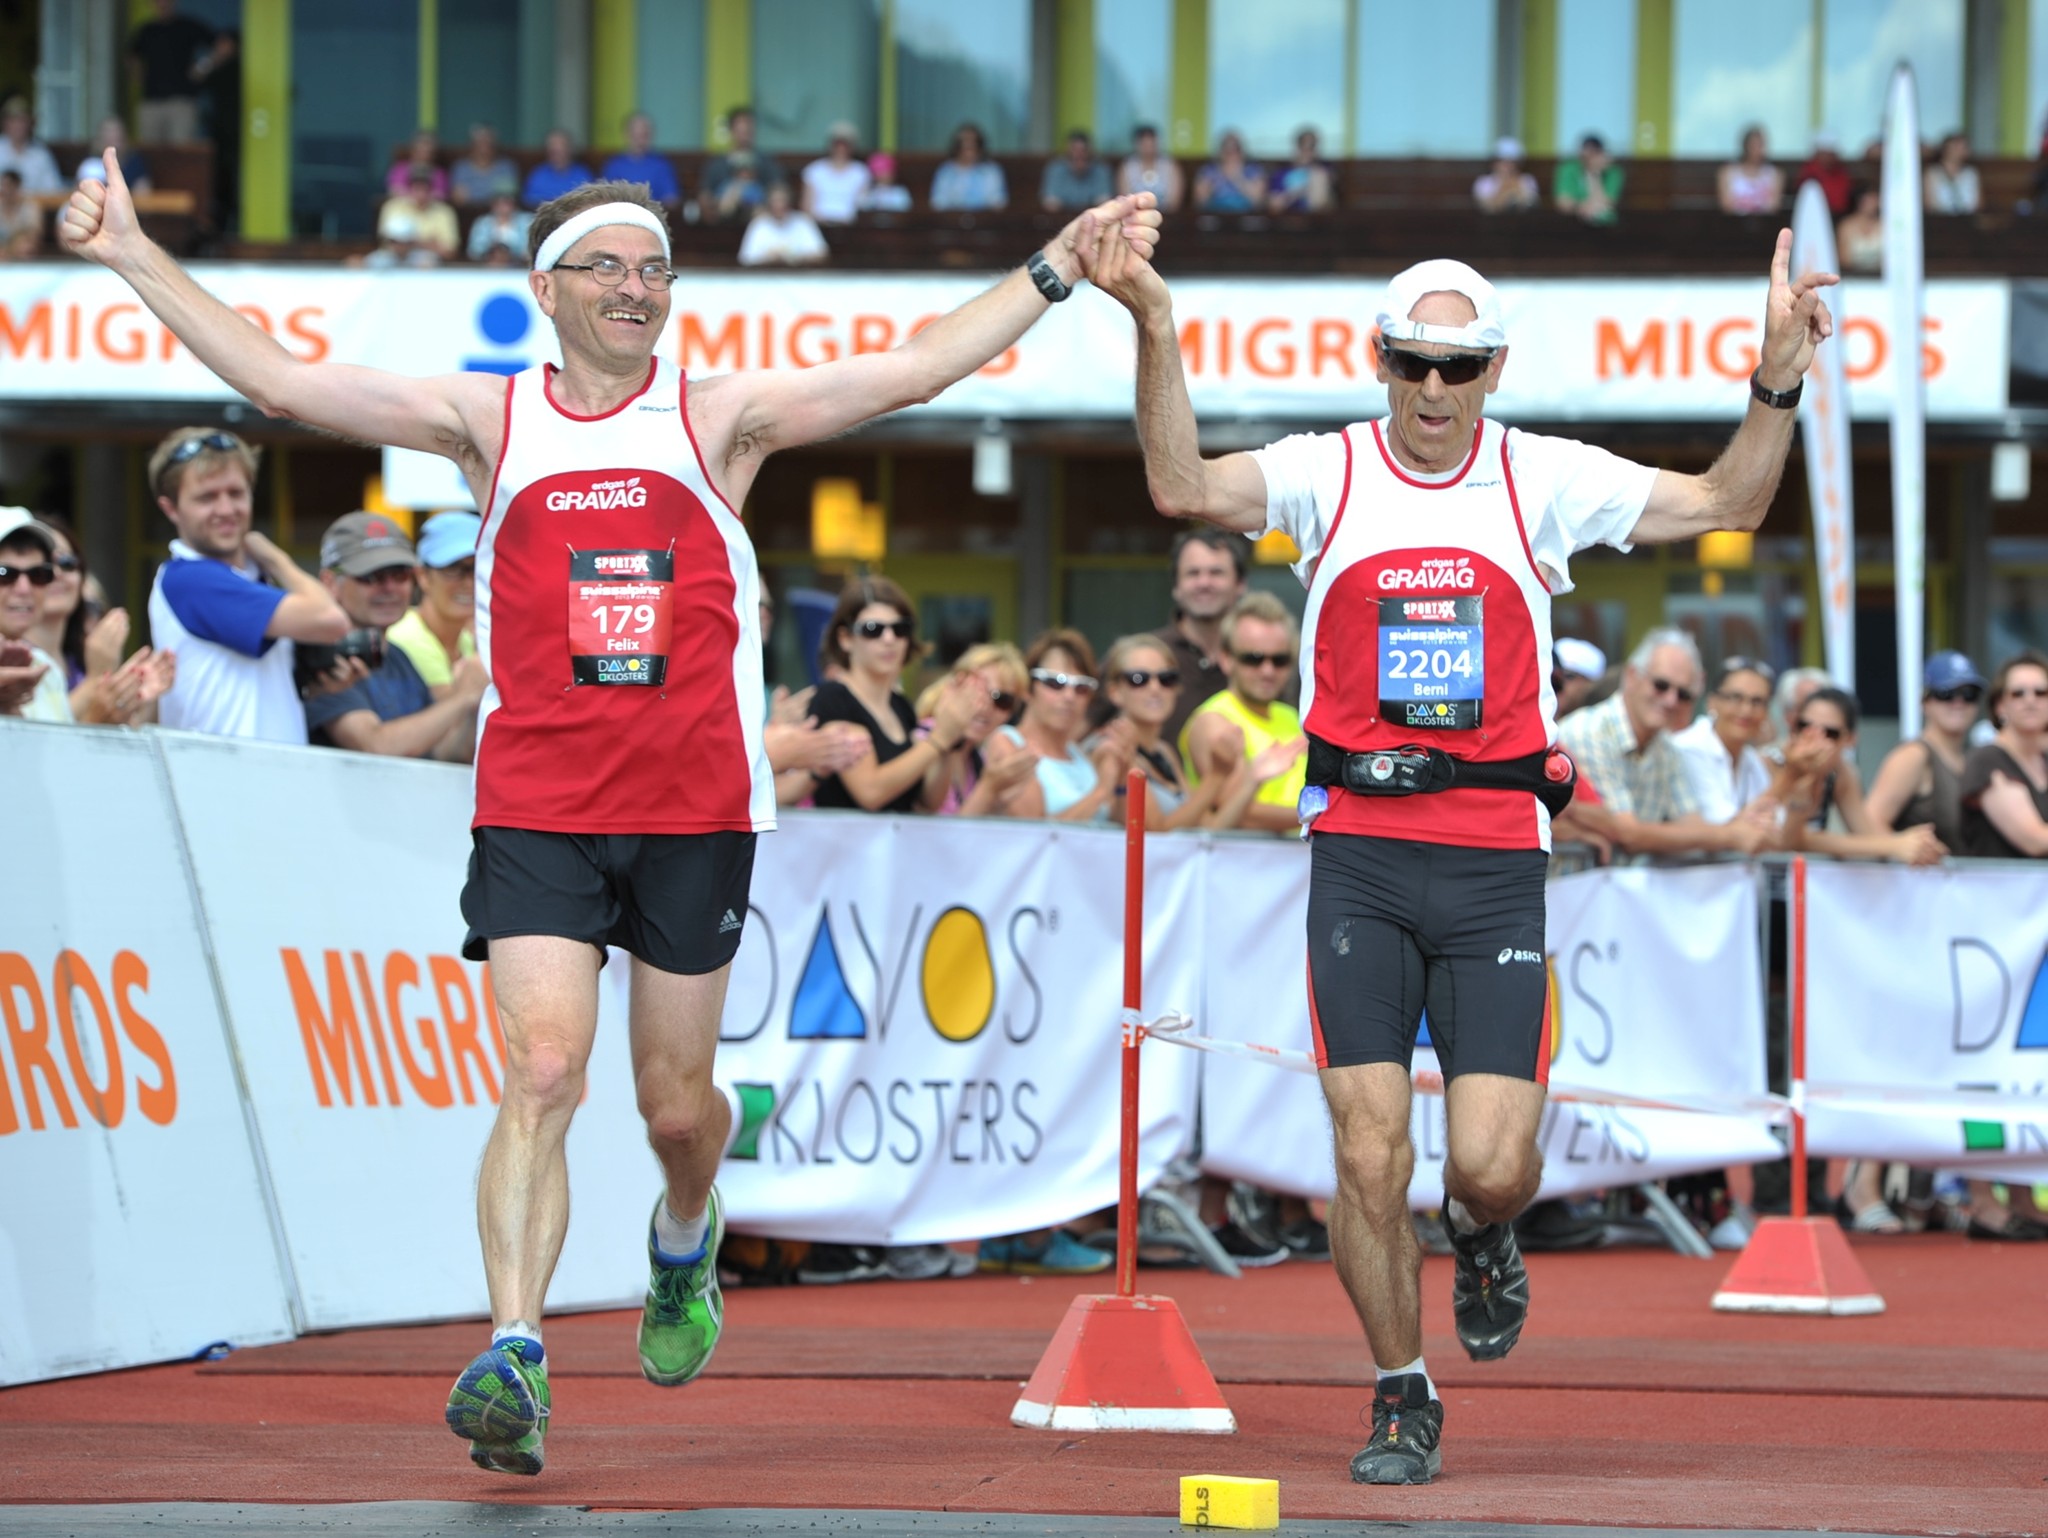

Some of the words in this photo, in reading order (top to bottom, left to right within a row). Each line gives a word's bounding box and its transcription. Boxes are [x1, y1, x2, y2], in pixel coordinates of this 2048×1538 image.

[591, 479, 625, 492] erdgas
[546, 487, 647, 511] GRAVAG
[1421, 558, 1454, 570] erdgas
[1377, 568, 1475, 589] GRAVAG
[591, 604, 656, 634] 179
[607, 638, 640, 651] Felix
[598, 658, 649, 673] DAVOS
[1388, 649, 1472, 679] 2204
[607, 672, 648, 682] KLOSTERS
[1413, 683, 1449, 696] Berni
[1406, 703, 1456, 716] DAVOS
[1415, 716, 1456, 726] KLOSTERS
[1513, 949, 1541, 963] asics
[0, 948, 178, 1136] ROS
[770, 1078, 1044, 1165] KLOSTERS
